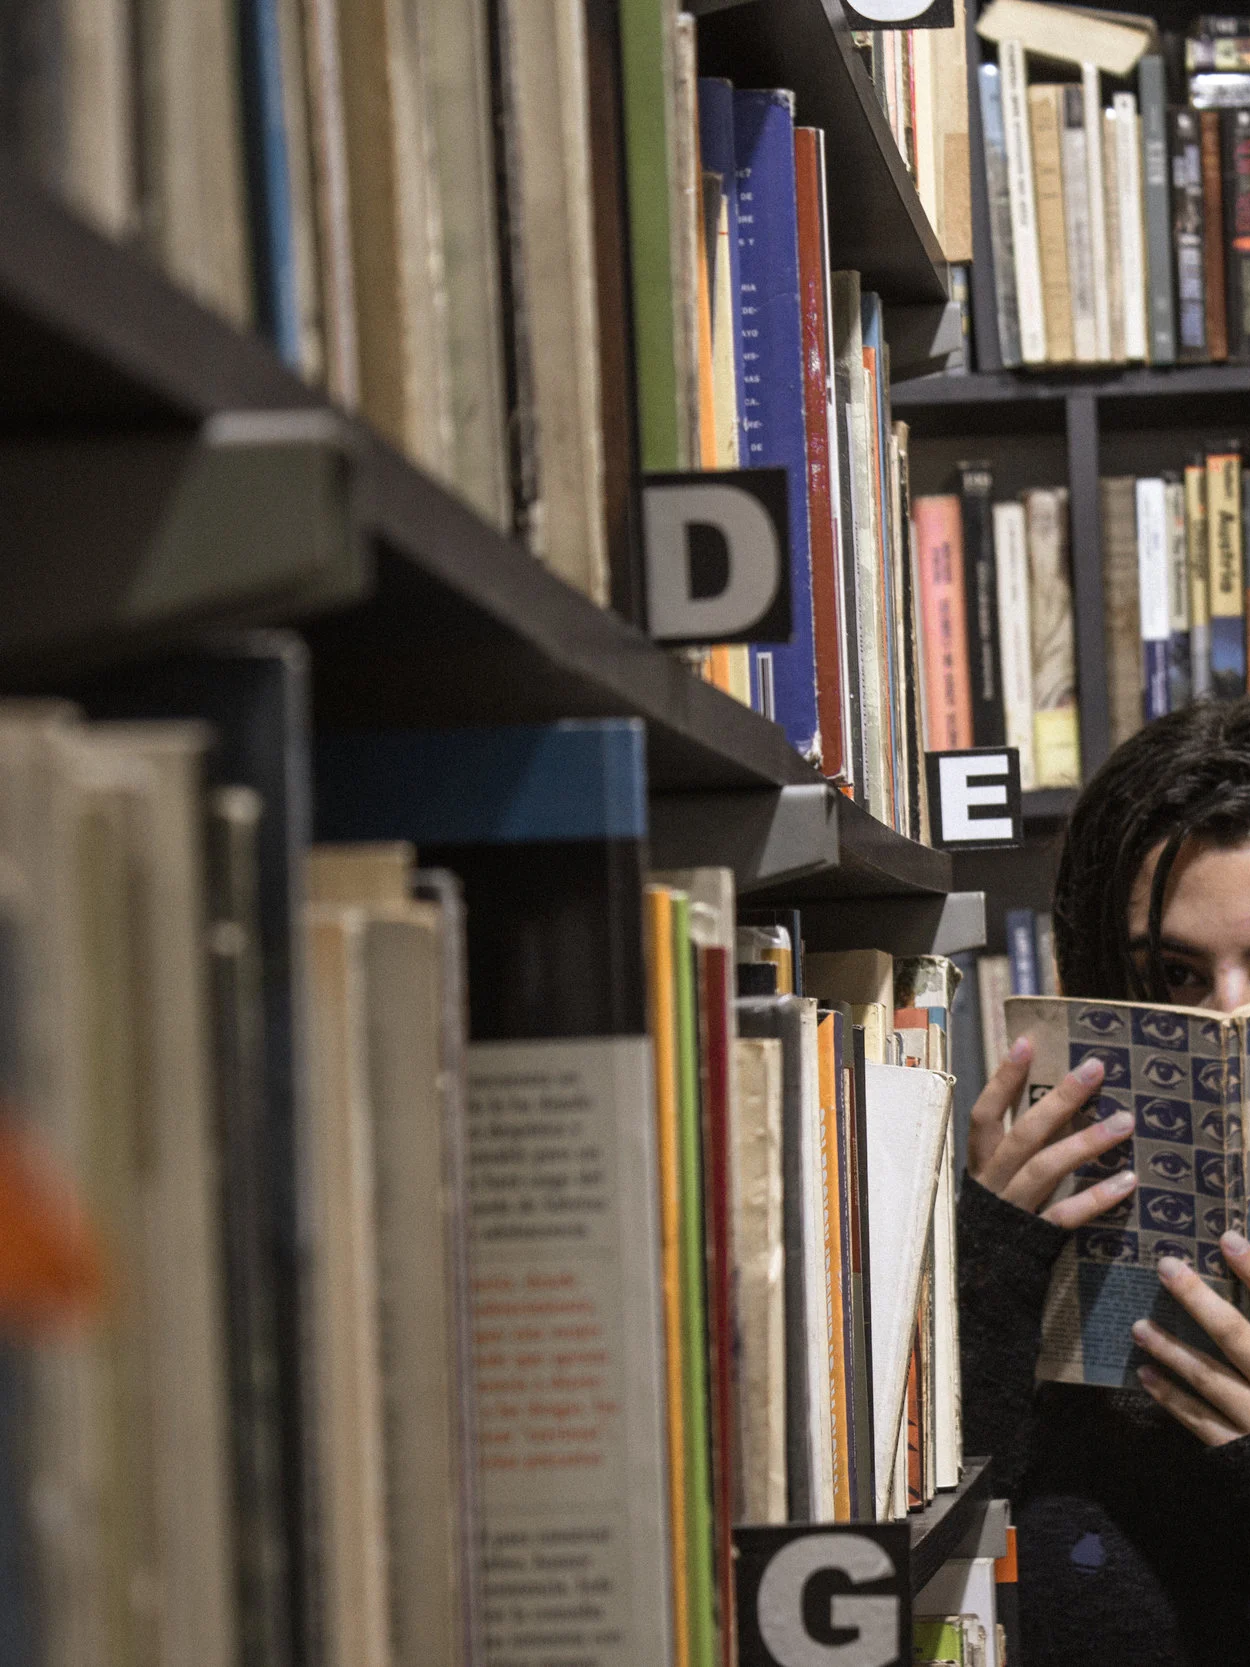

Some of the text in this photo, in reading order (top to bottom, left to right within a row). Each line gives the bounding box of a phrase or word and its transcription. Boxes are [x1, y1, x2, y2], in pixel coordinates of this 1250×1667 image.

[643, 484, 783, 640] D
[1217, 508, 1237, 594] Austria
[939, 755, 1013, 842] E
[757, 1532, 899, 1667] G
